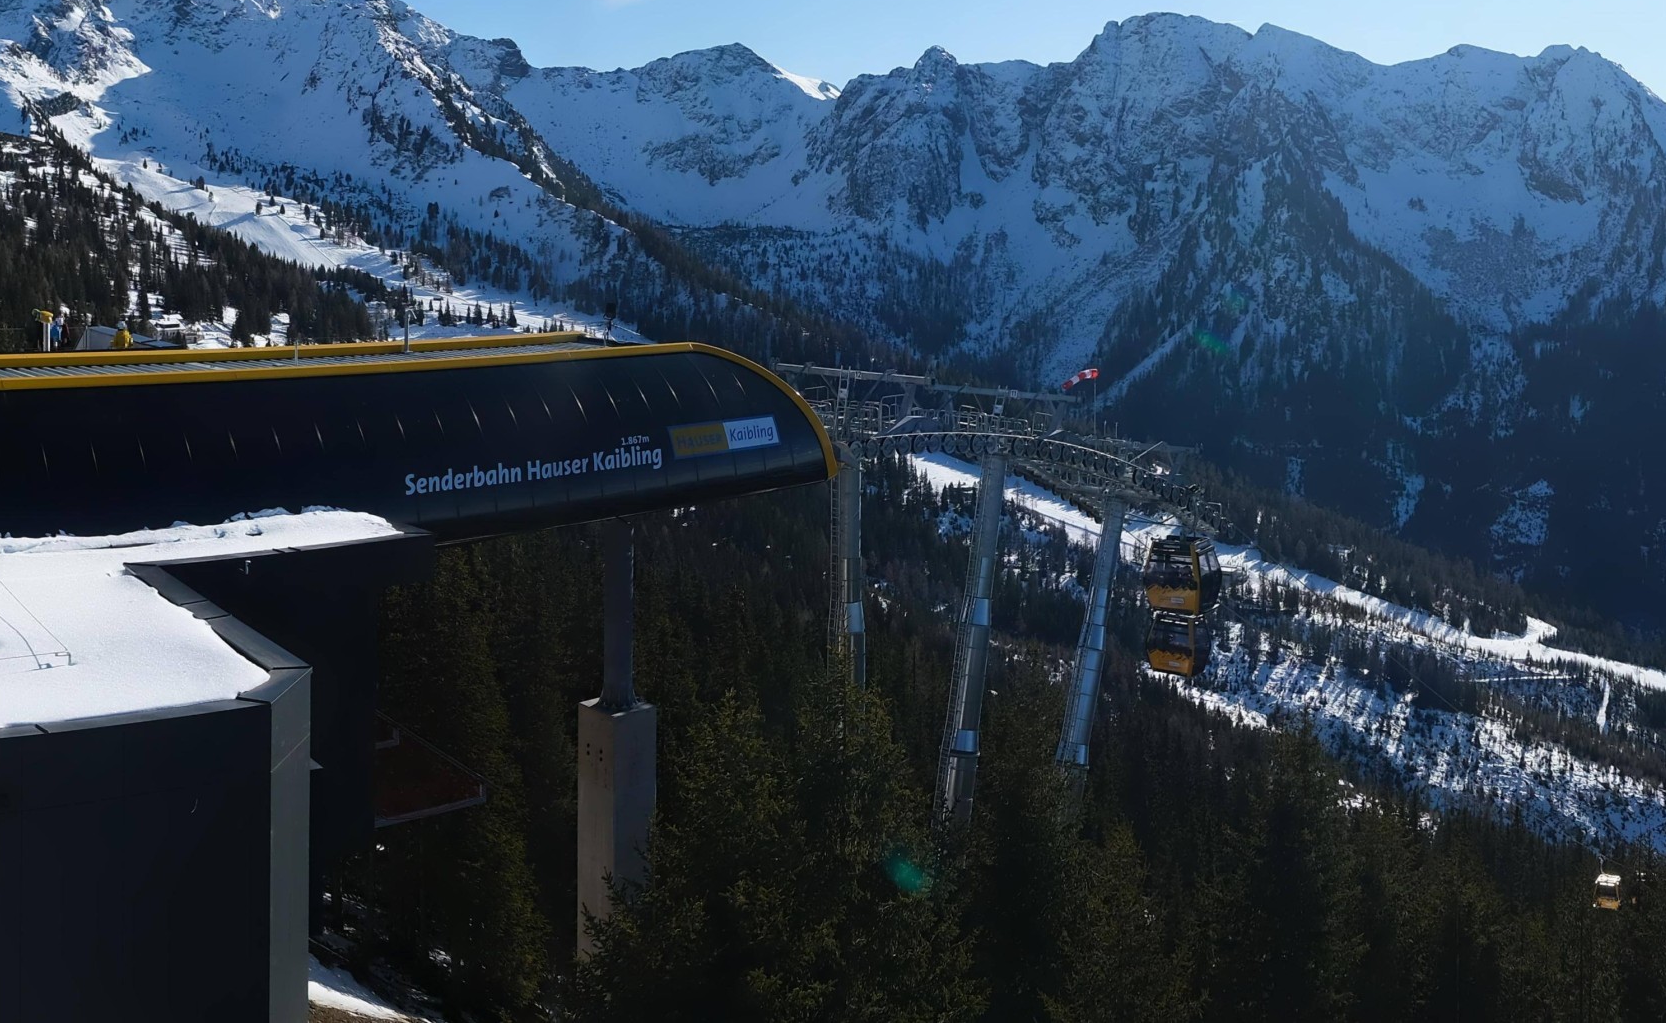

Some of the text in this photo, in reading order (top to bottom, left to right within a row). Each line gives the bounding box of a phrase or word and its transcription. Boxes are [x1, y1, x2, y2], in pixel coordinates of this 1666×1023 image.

[620, 434, 650, 446] 1.867m
[675, 424, 775, 450] HAUSER Kaibling
[404, 445, 663, 496] Senderbahn Hauser Kaibling
